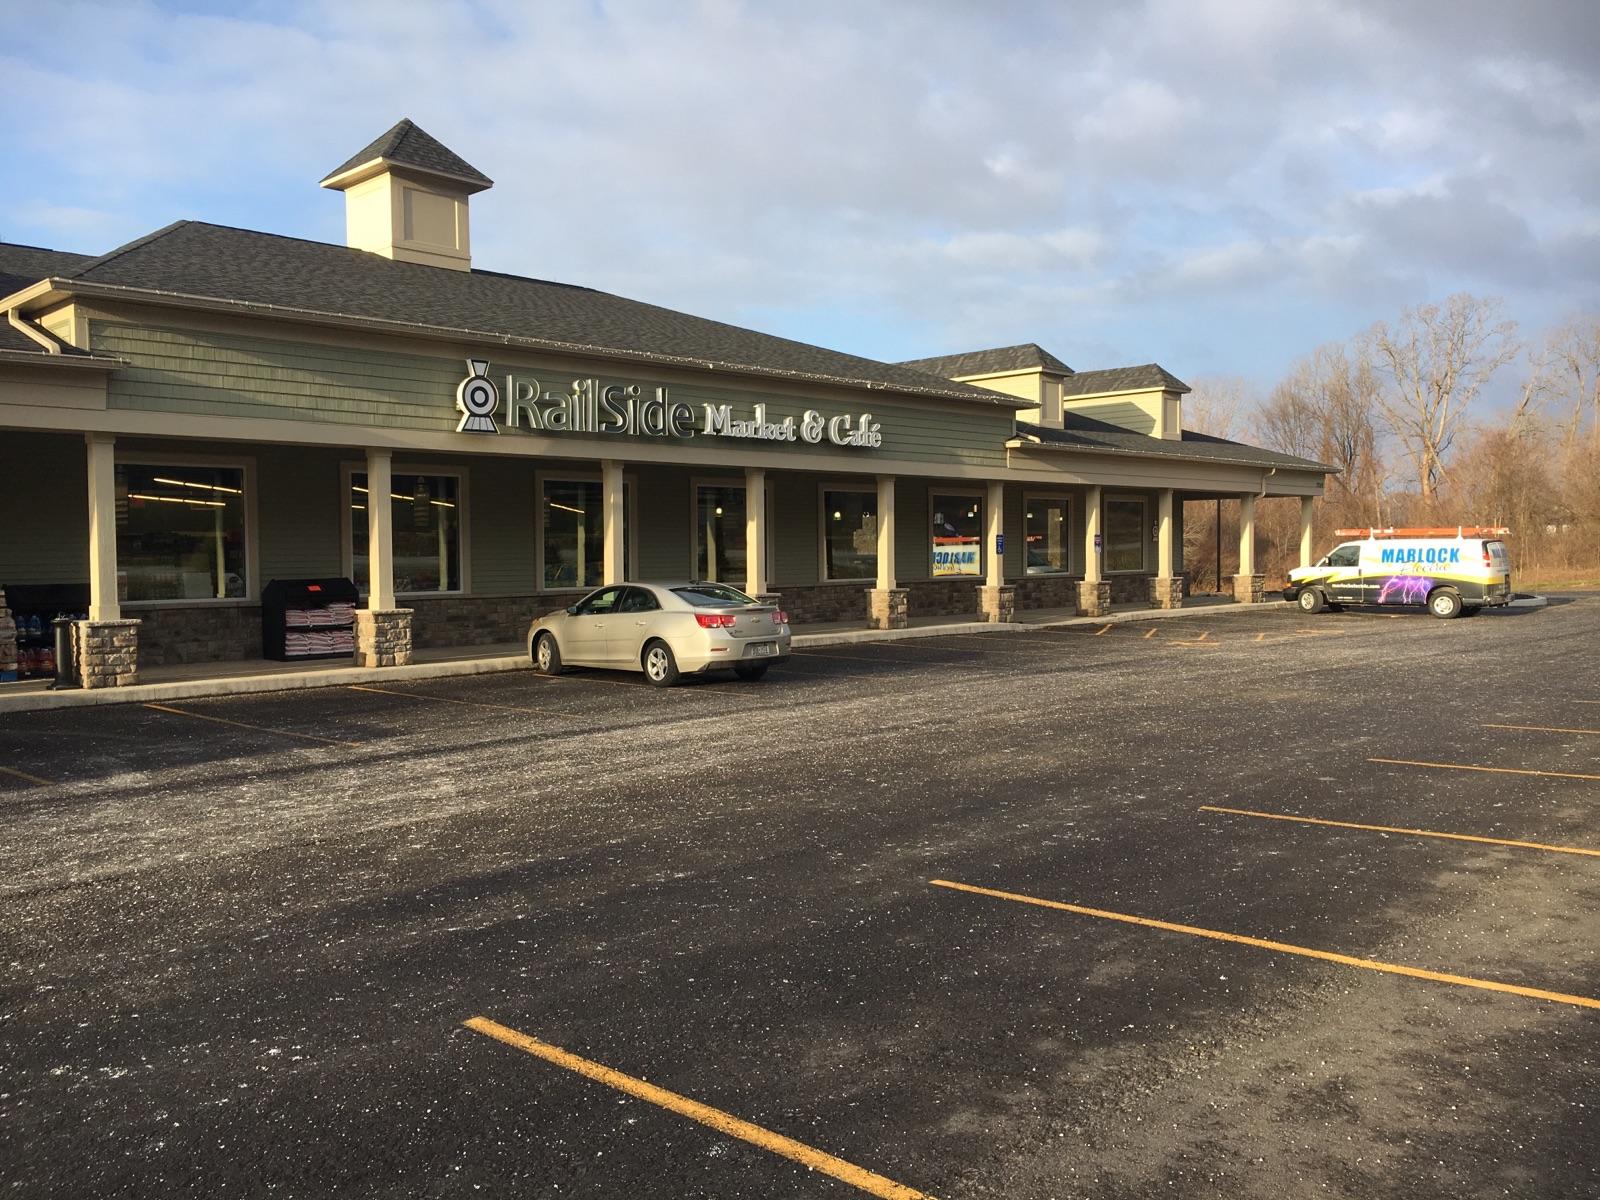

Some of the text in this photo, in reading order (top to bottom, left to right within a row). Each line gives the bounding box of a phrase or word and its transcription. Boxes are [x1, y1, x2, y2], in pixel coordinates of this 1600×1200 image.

[505, 374, 882, 448] RailSide Market & Café
